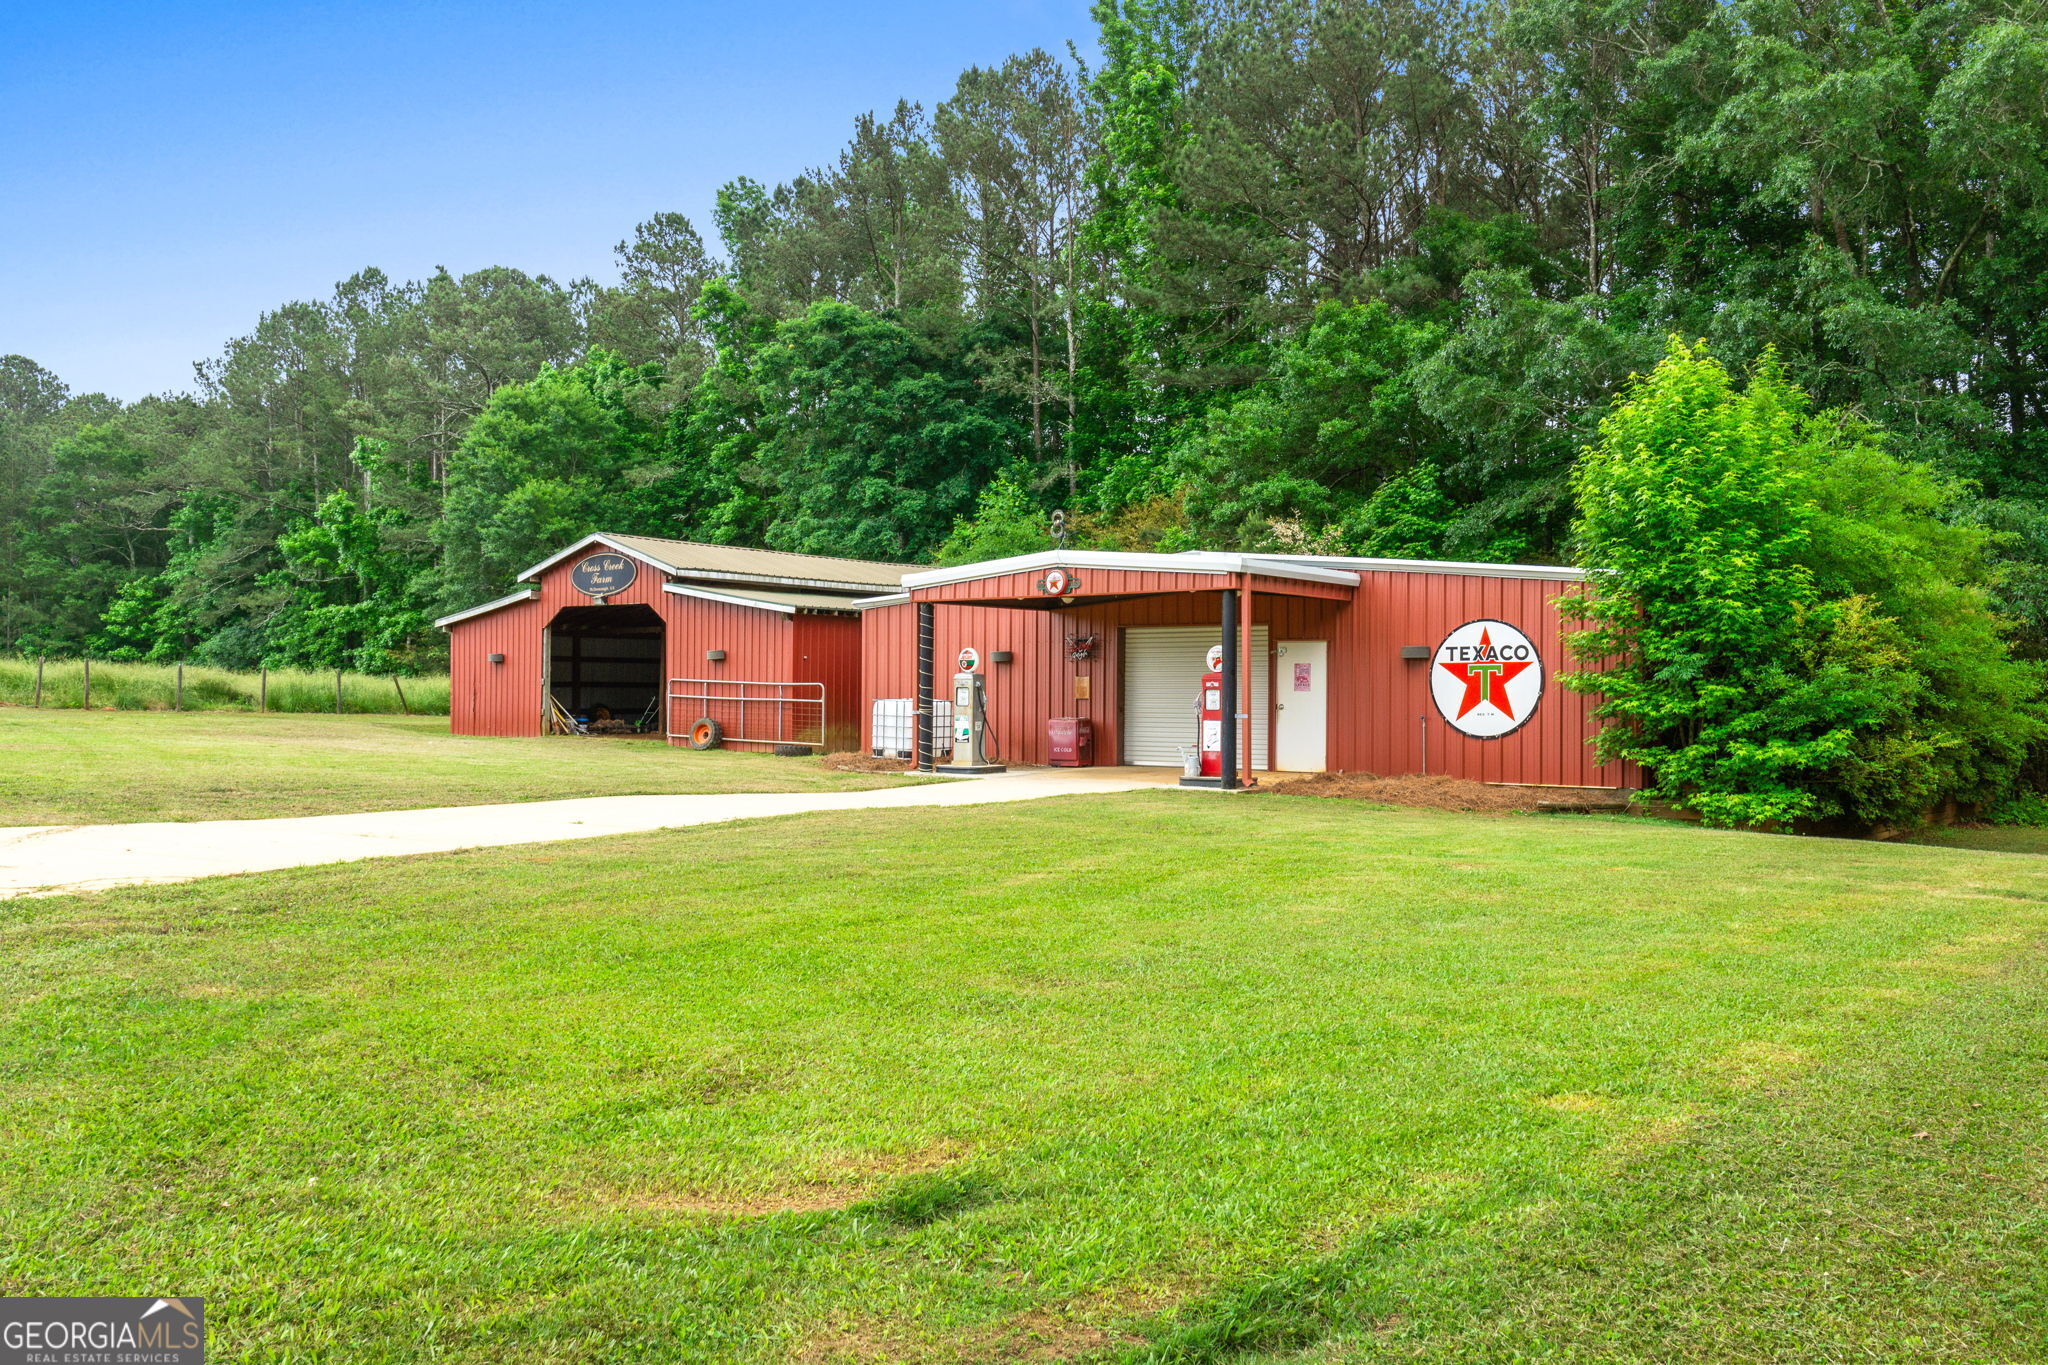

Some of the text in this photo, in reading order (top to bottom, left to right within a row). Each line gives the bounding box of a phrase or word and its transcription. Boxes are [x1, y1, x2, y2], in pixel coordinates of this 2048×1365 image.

[581, 559, 625, 573] Cross Creek
[590, 572, 613, 584] Farm
[1445, 645, 1530, 662] TEXACO
[1468, 664, 1503, 702] T
